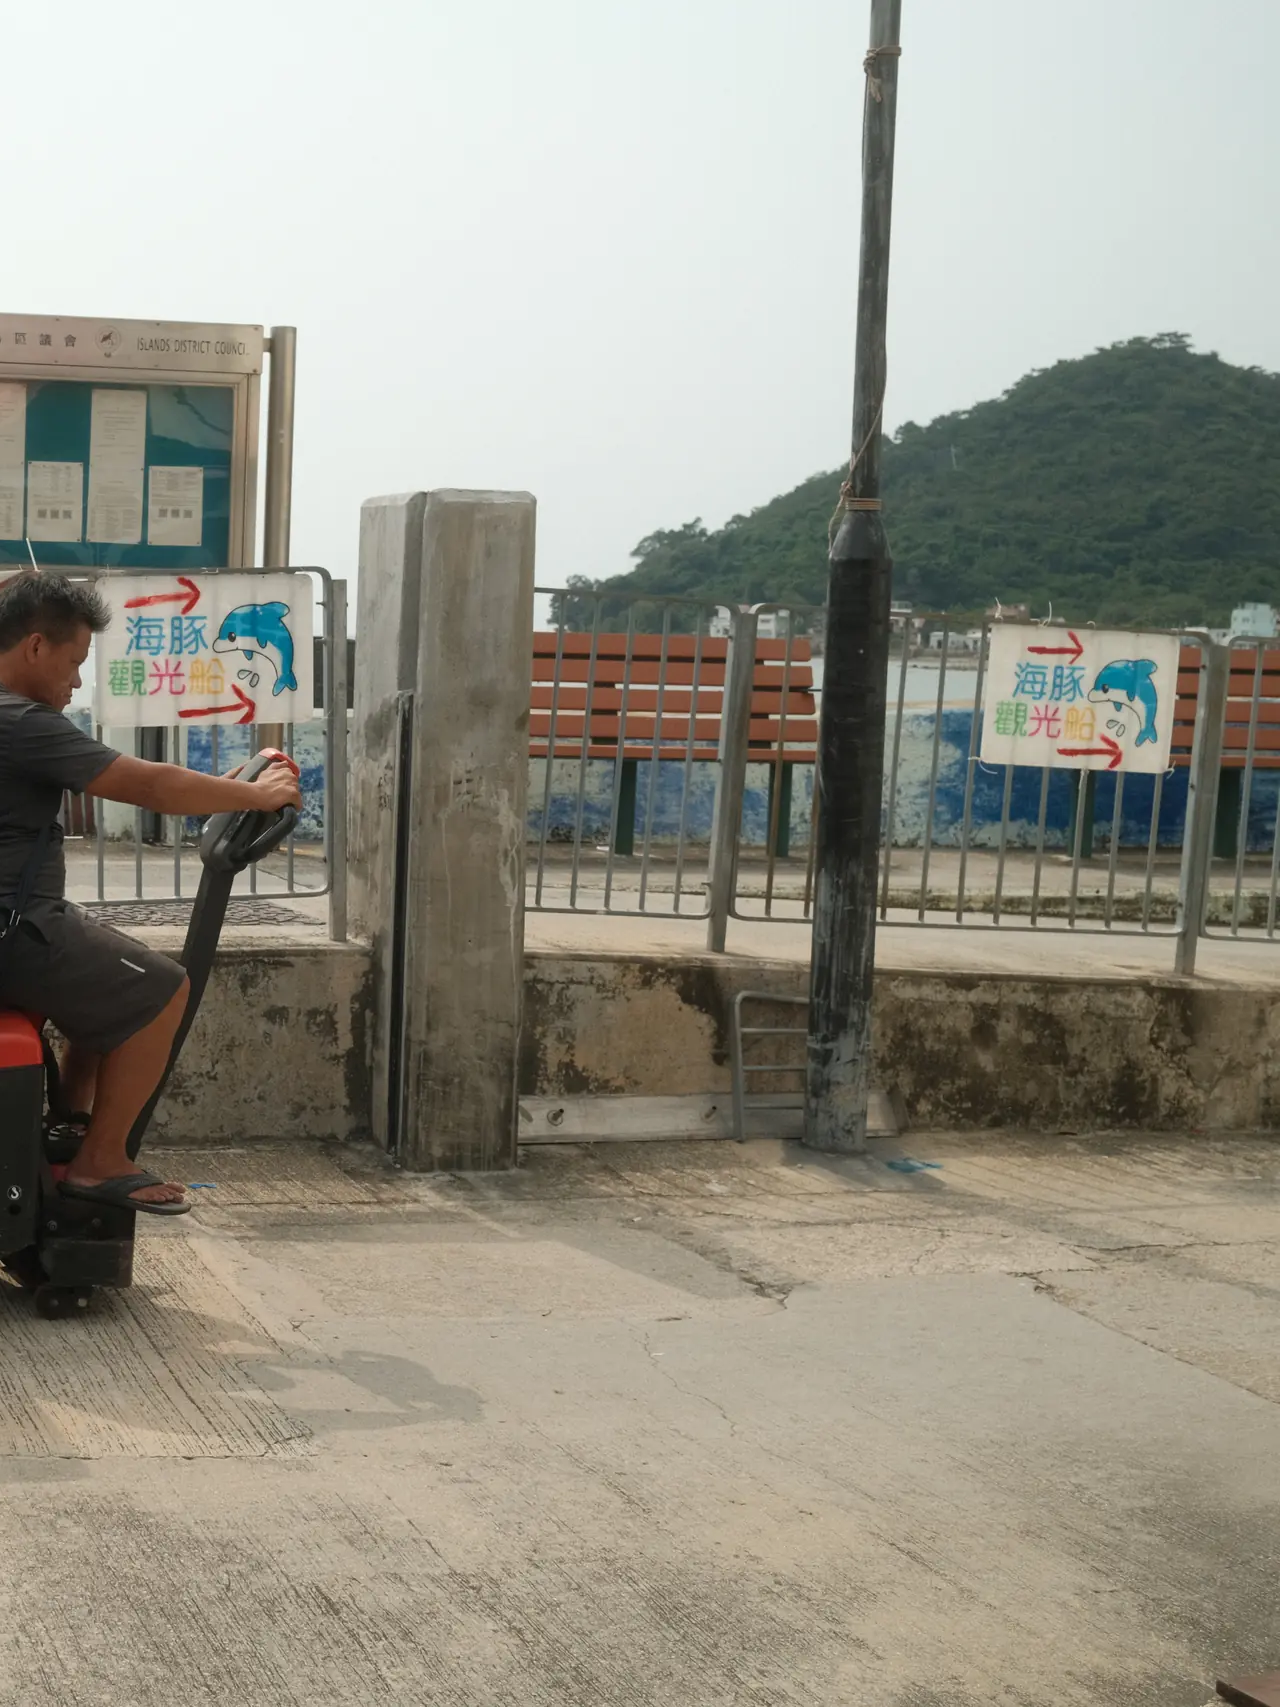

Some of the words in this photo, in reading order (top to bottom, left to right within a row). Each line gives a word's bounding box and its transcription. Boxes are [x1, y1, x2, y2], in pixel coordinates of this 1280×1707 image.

[137, 336, 171, 352] ISLANDS
[174, 339, 211, 354] DISTRICT
[126, 615, 208, 656] 海豚
[108, 658, 225, 696] 觀光船
[1012, 662, 1086, 702] 海豚
[994, 700, 1096, 742] 觀光船
